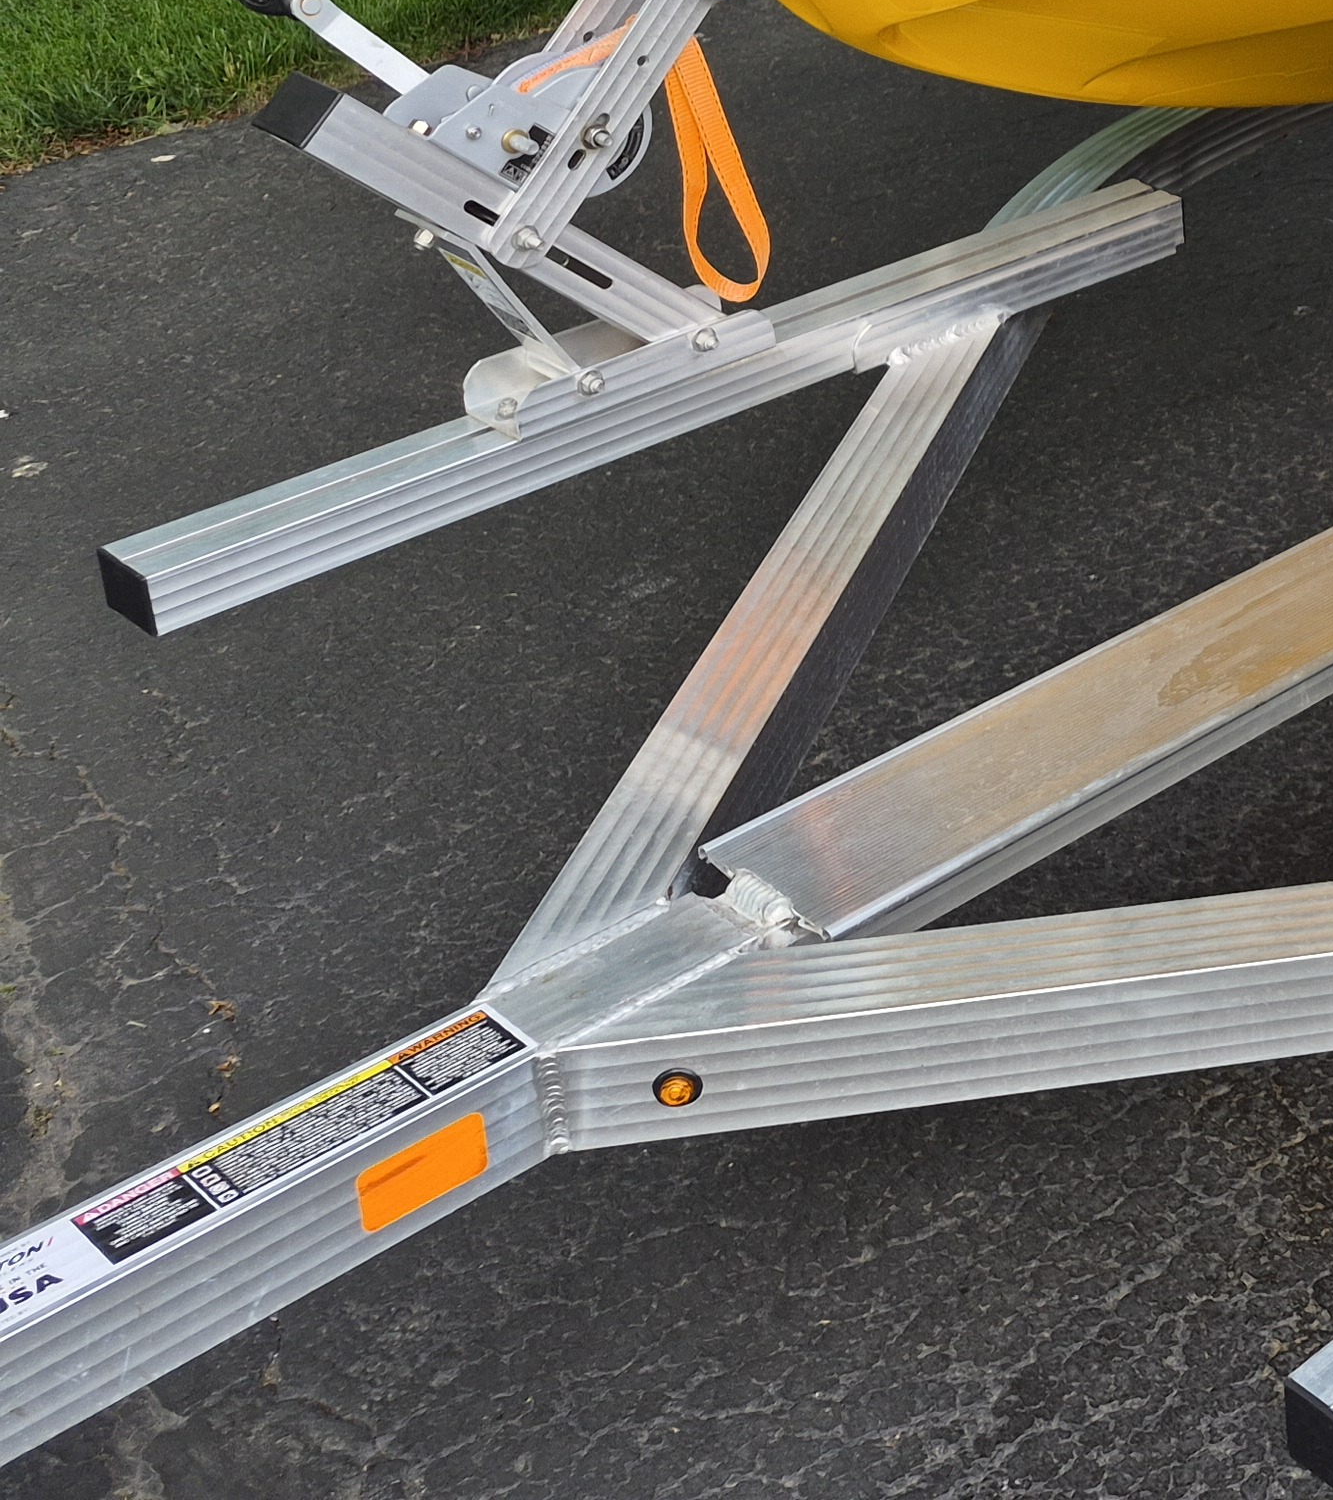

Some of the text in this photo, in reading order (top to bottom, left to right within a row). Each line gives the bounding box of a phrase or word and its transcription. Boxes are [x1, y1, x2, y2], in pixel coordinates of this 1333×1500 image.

[407, 1014, 482, 1053] WARNING
[203, 1117, 279, 1159] CAUTION
[97, 1173, 173, 1214] DANGER
